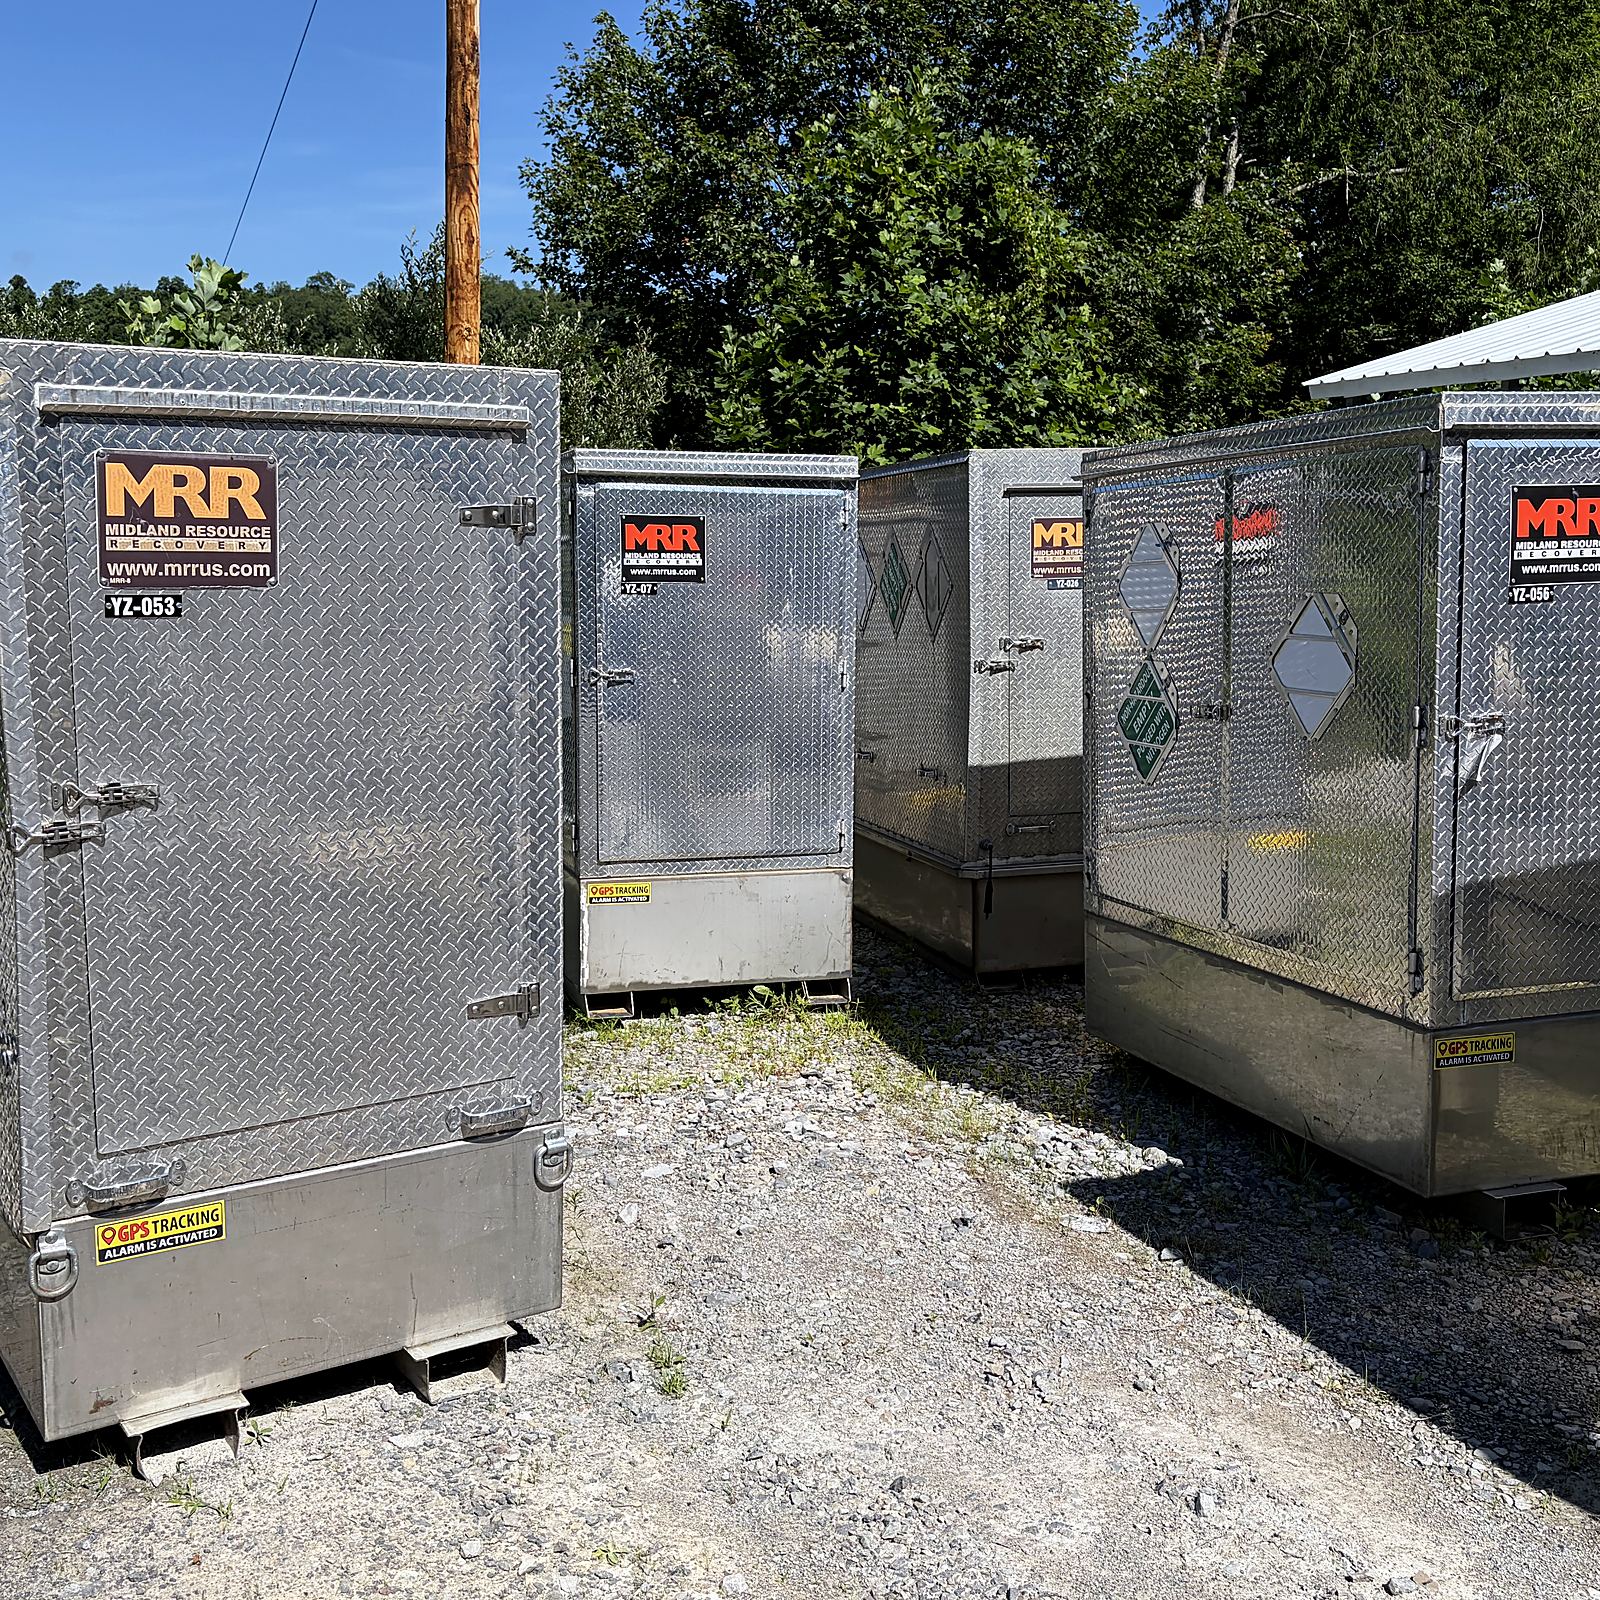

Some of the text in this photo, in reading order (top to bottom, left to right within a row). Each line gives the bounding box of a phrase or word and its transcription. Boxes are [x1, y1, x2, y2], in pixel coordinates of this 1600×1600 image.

[105, 462, 267, 520] MRR
[1517, 498, 1600, 537] MRR
[105, 524, 271, 538] MIDLAND RESOURCE
[625, 523, 700, 551] MRR
[110, 540, 266, 550] RECOVERY
[1515, 539, 1600, 550] MIDLAND RESOUR
[107, 562, 271, 577] www.mrrus.com
[630, 568, 697, 576] www.mrrus.com
[625, 583, 652, 594] YZ-07
[1056, 580, 1079, 588] YZ-026
[1512, 586, 1550, 602] YZ-056
[110, 596, 176, 616] YZ-053
[1145, 720, 1170, 764] NITOGEN
[598, 886, 649, 896] GPS TRACKING
[1448, 1037, 1512, 1055] GPS TRACKING
[1439, 1052, 1510, 1066] ALARM IS ACTIVATED
[118, 1208, 219, 1242] GPS TRACKING
[104, 1228, 218, 1259] ALARM IS ACTIVATED
